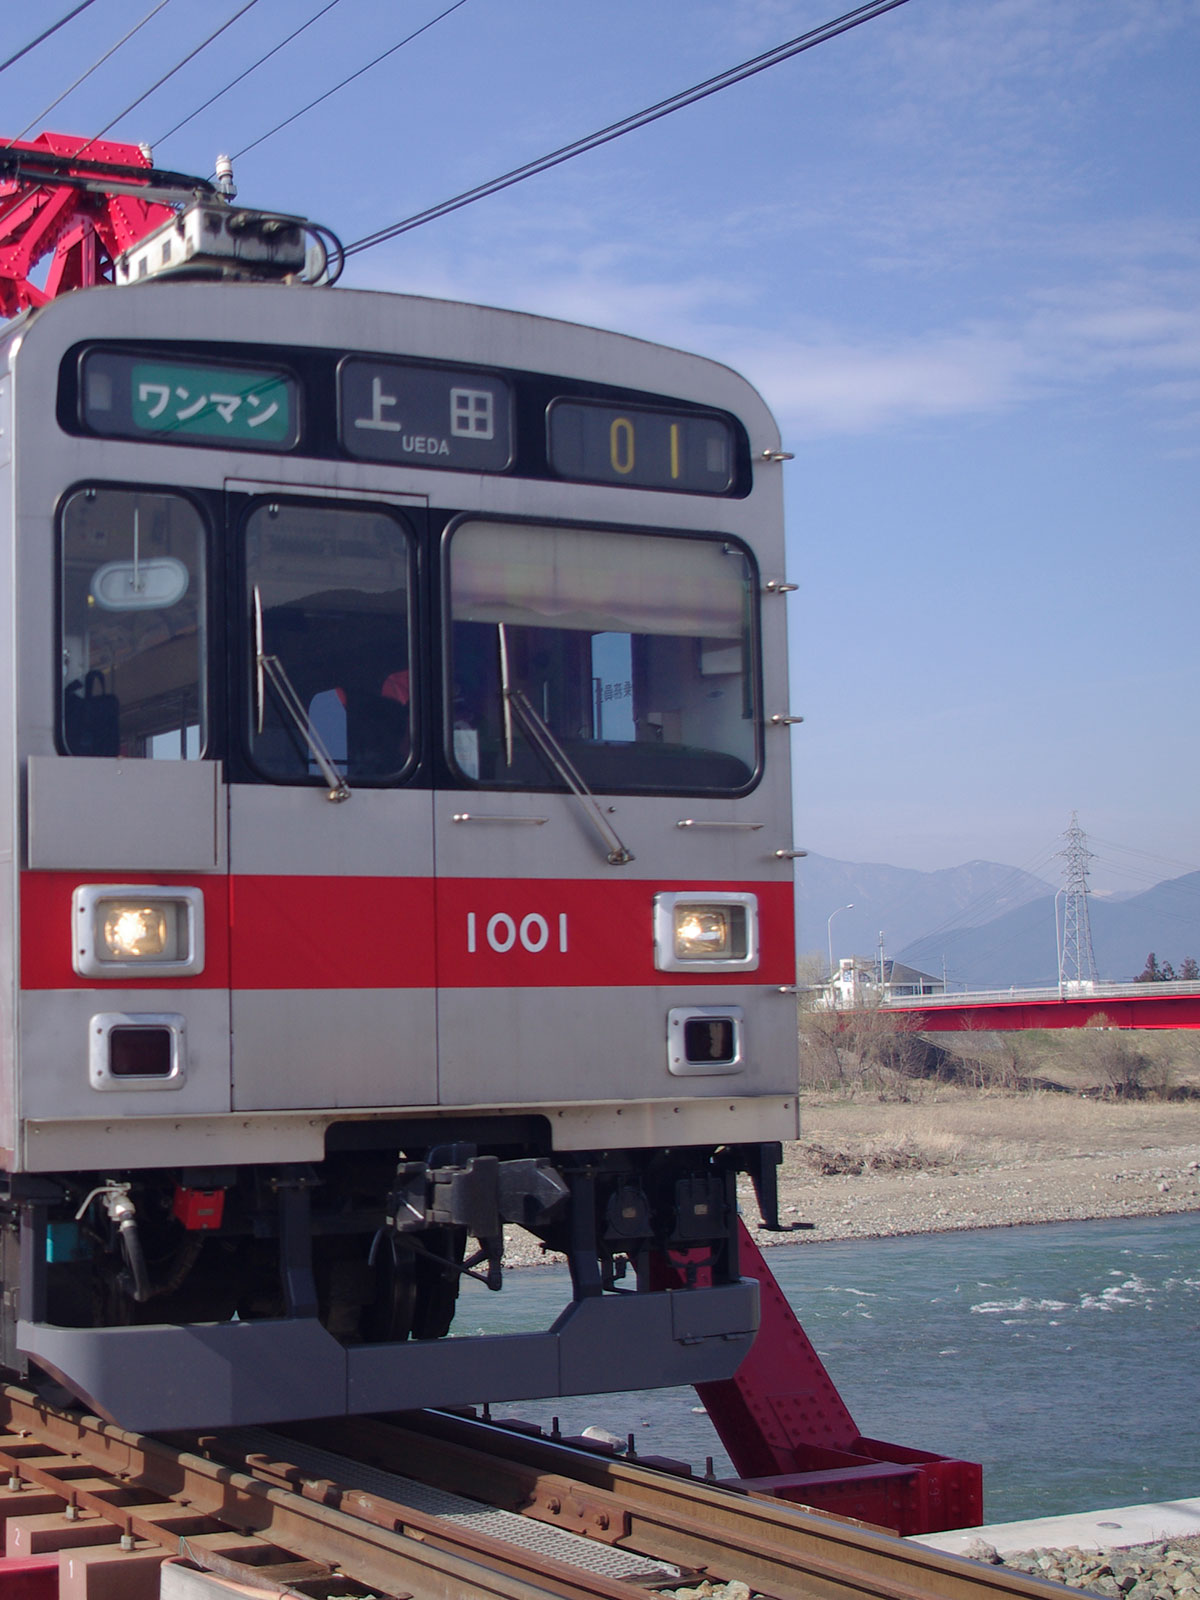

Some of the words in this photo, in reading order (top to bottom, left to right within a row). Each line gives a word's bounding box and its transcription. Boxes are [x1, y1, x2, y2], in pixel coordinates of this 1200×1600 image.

[139, 383, 279, 427] ワンマン
[354, 377, 494, 440] 上田
[402, 435, 450, 455] UEDA
[610, 417, 679, 479] 01
[467, 912, 568, 953] 1001
[14, 1527, 21, 1547] 2
